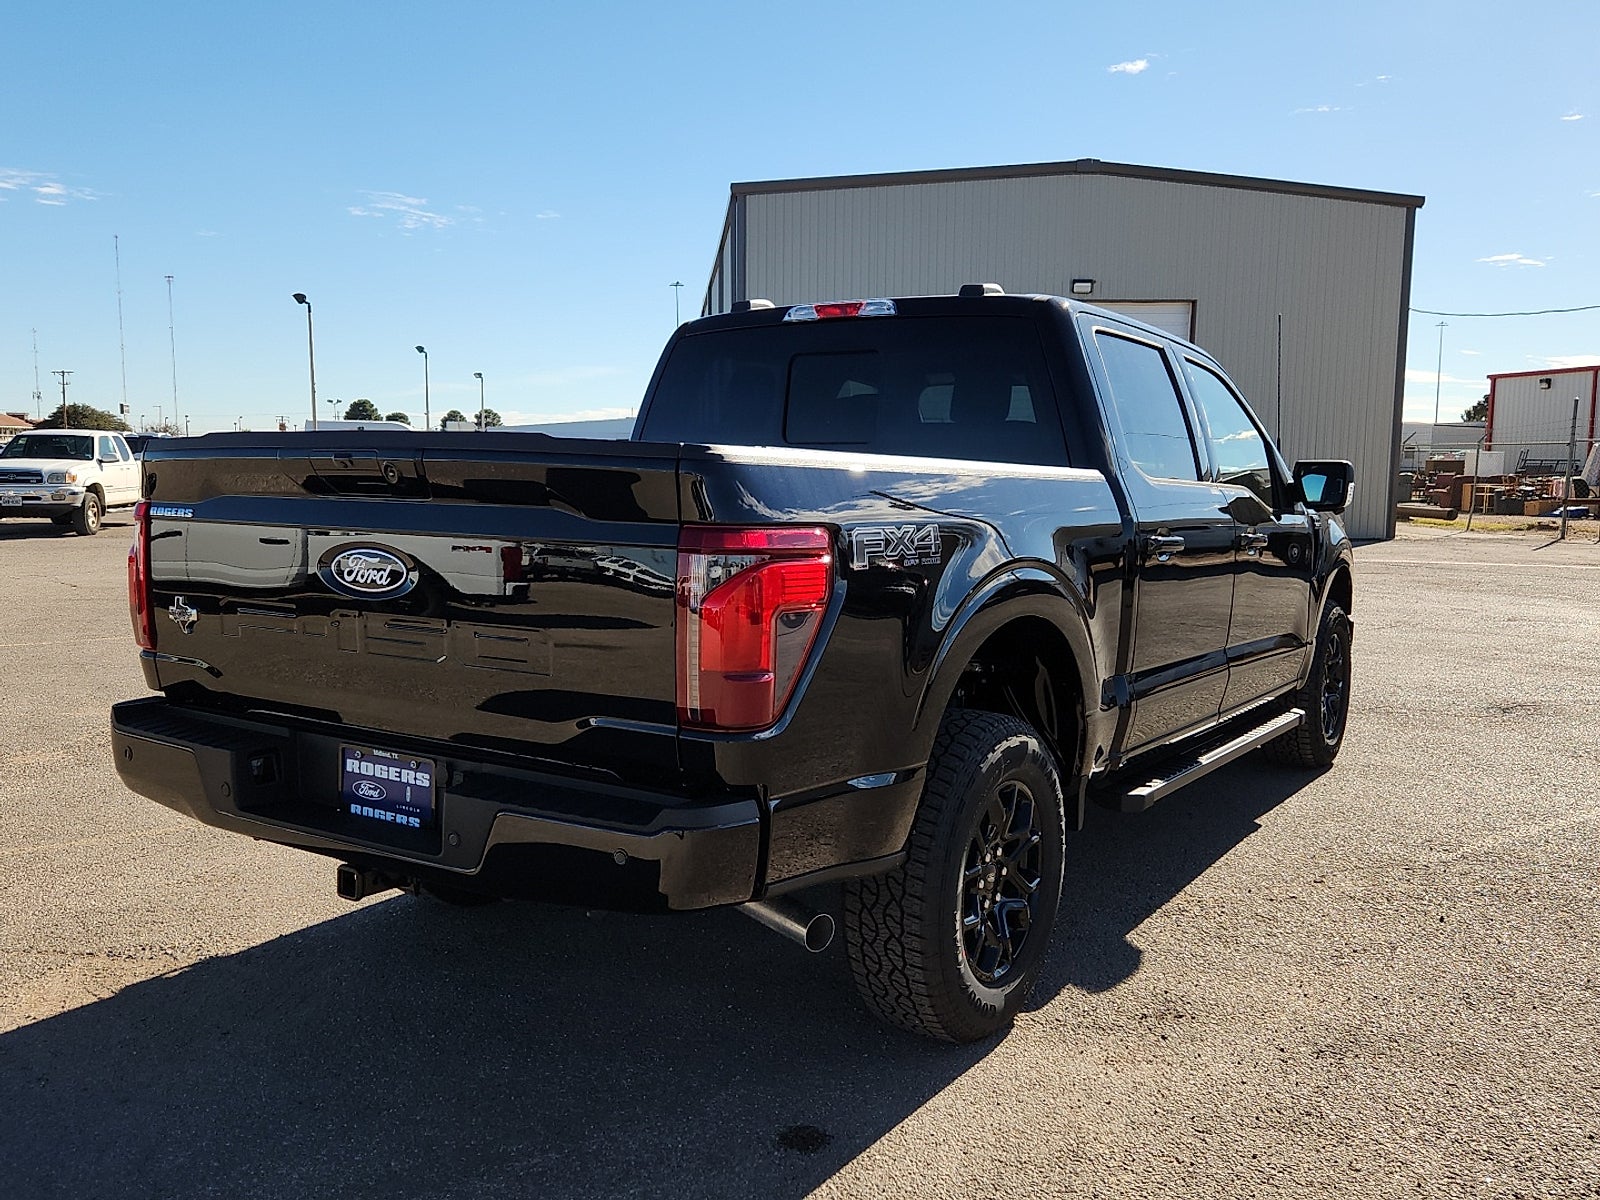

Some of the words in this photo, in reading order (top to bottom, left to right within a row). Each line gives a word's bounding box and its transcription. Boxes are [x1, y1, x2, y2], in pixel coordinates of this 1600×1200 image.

[150, 505, 194, 518] ROGERS
[852, 524, 942, 570] FX4
[344, 554, 392, 586] Ford
[346, 758, 430, 787] ROGERS
[358, 783, 380, 797] Ford
[350, 803, 420, 827] ROGERS
